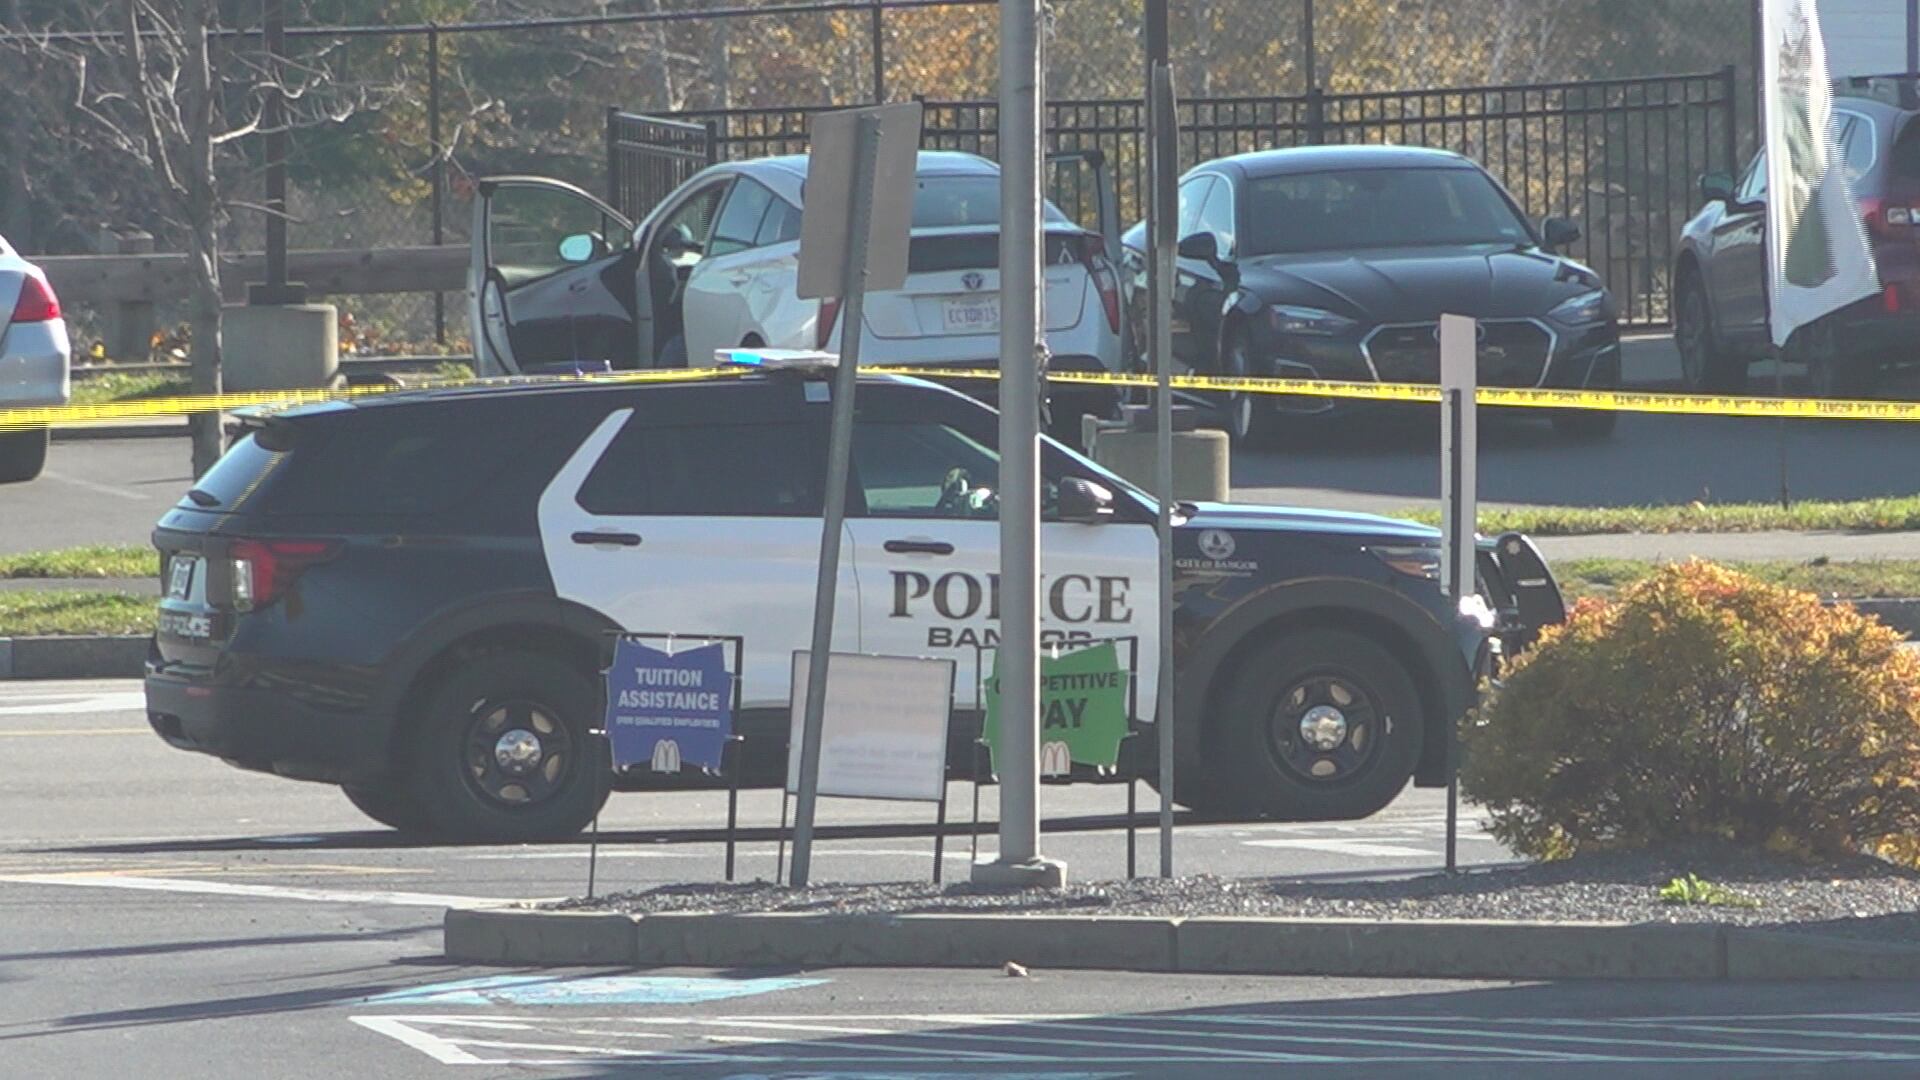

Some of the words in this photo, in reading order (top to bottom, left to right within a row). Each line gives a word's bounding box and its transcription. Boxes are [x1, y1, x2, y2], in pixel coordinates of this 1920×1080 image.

[889, 570, 1133, 624] POCE
[928, 627, 1092, 650] BANOR
[635, 667, 703, 687] TUITION
[618, 690, 720, 711] ASSISTANCE
[1041, 698, 1088, 729] AY
